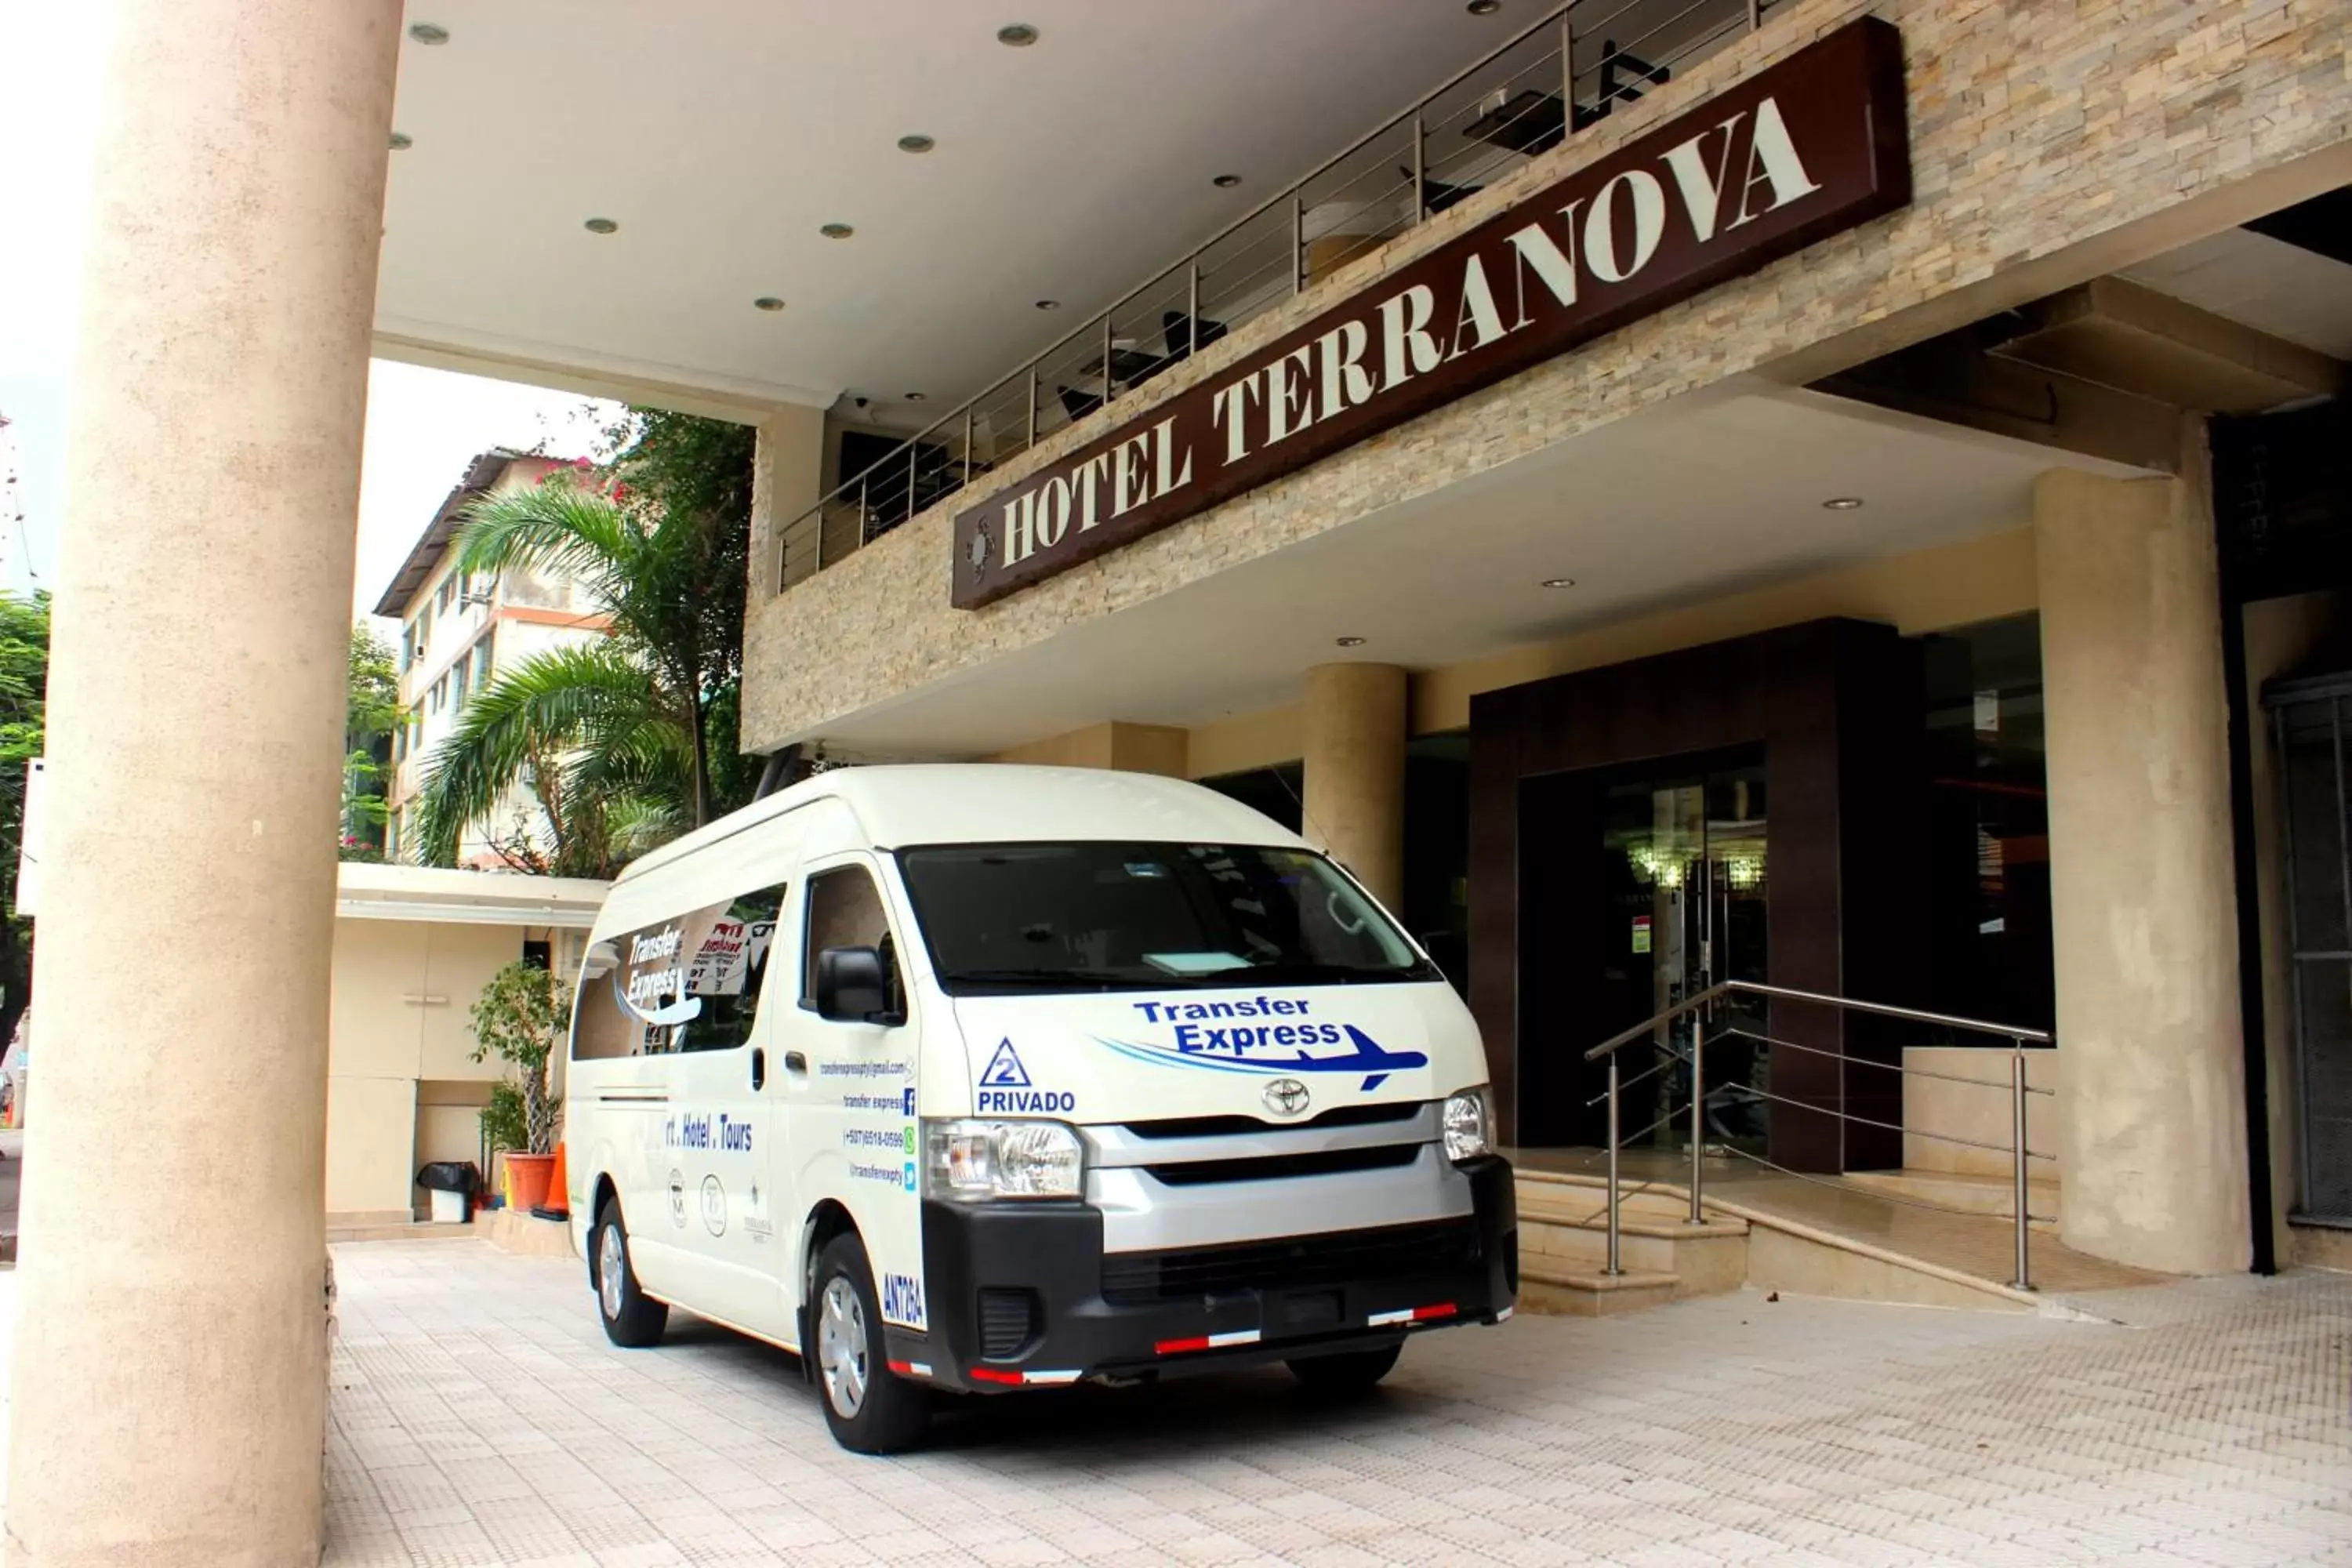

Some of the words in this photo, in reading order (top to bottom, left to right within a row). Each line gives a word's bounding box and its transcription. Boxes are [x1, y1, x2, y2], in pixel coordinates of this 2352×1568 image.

[1000, 415, 1192, 569] HOTEL
[1213, 96, 1823, 468] TERRANOVA
[629, 926, 681, 966] Transfer
[628, 967, 678, 1007] Express
[1134, 996, 1309, 1023] Transfer
[1174, 1023, 1342, 1057] Express
[993, 1058, 1016, 1083] 2
[843, 1094, 870, 1109] transfer
[873, 1098, 903, 1114] express
[978, 1091, 1075, 1113] PRIVADO
[684, 1112, 711, 1149] Hotel
[720, 1112, 753, 1152] Tours
